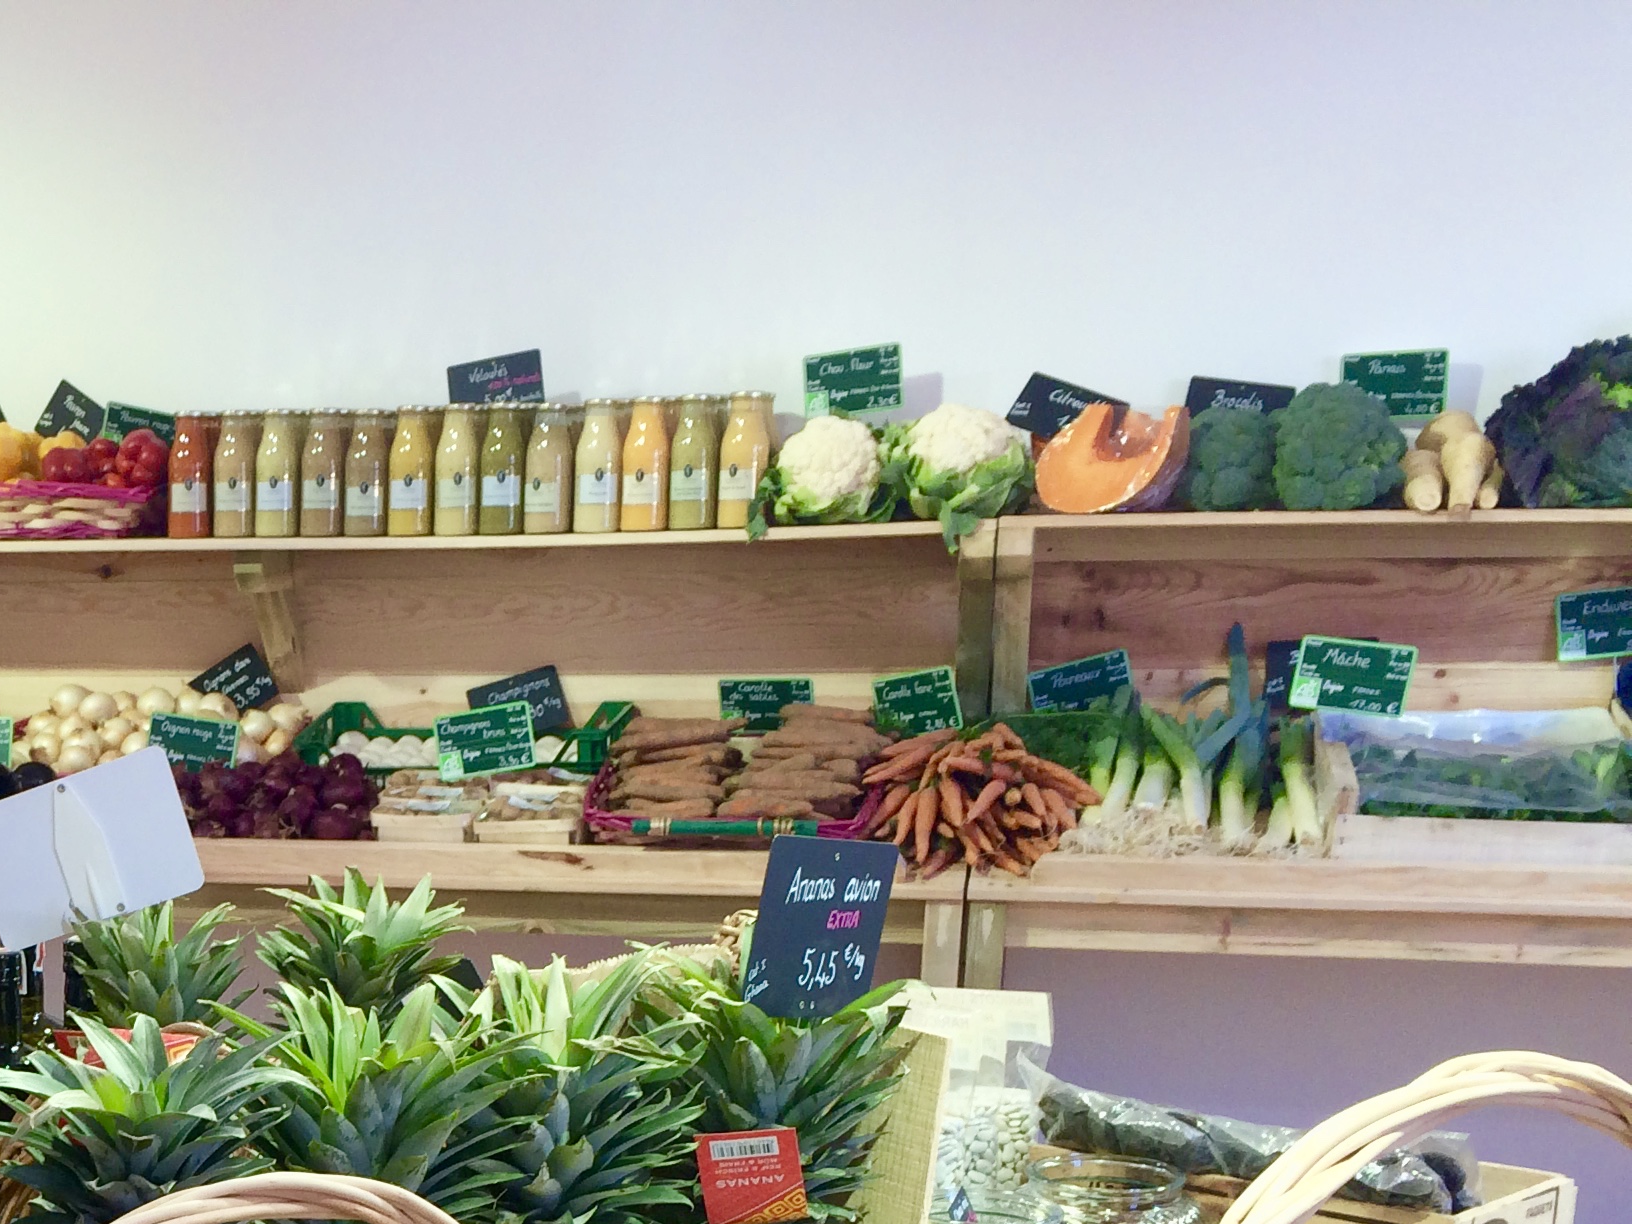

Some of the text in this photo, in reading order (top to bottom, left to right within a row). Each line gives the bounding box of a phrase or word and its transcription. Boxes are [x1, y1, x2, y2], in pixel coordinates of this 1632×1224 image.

[785, 867, 881, 904] Ananas avion
[827, 910, 861, 929] EXTRA
[715, 1174, 784, 1188] ANANAS
